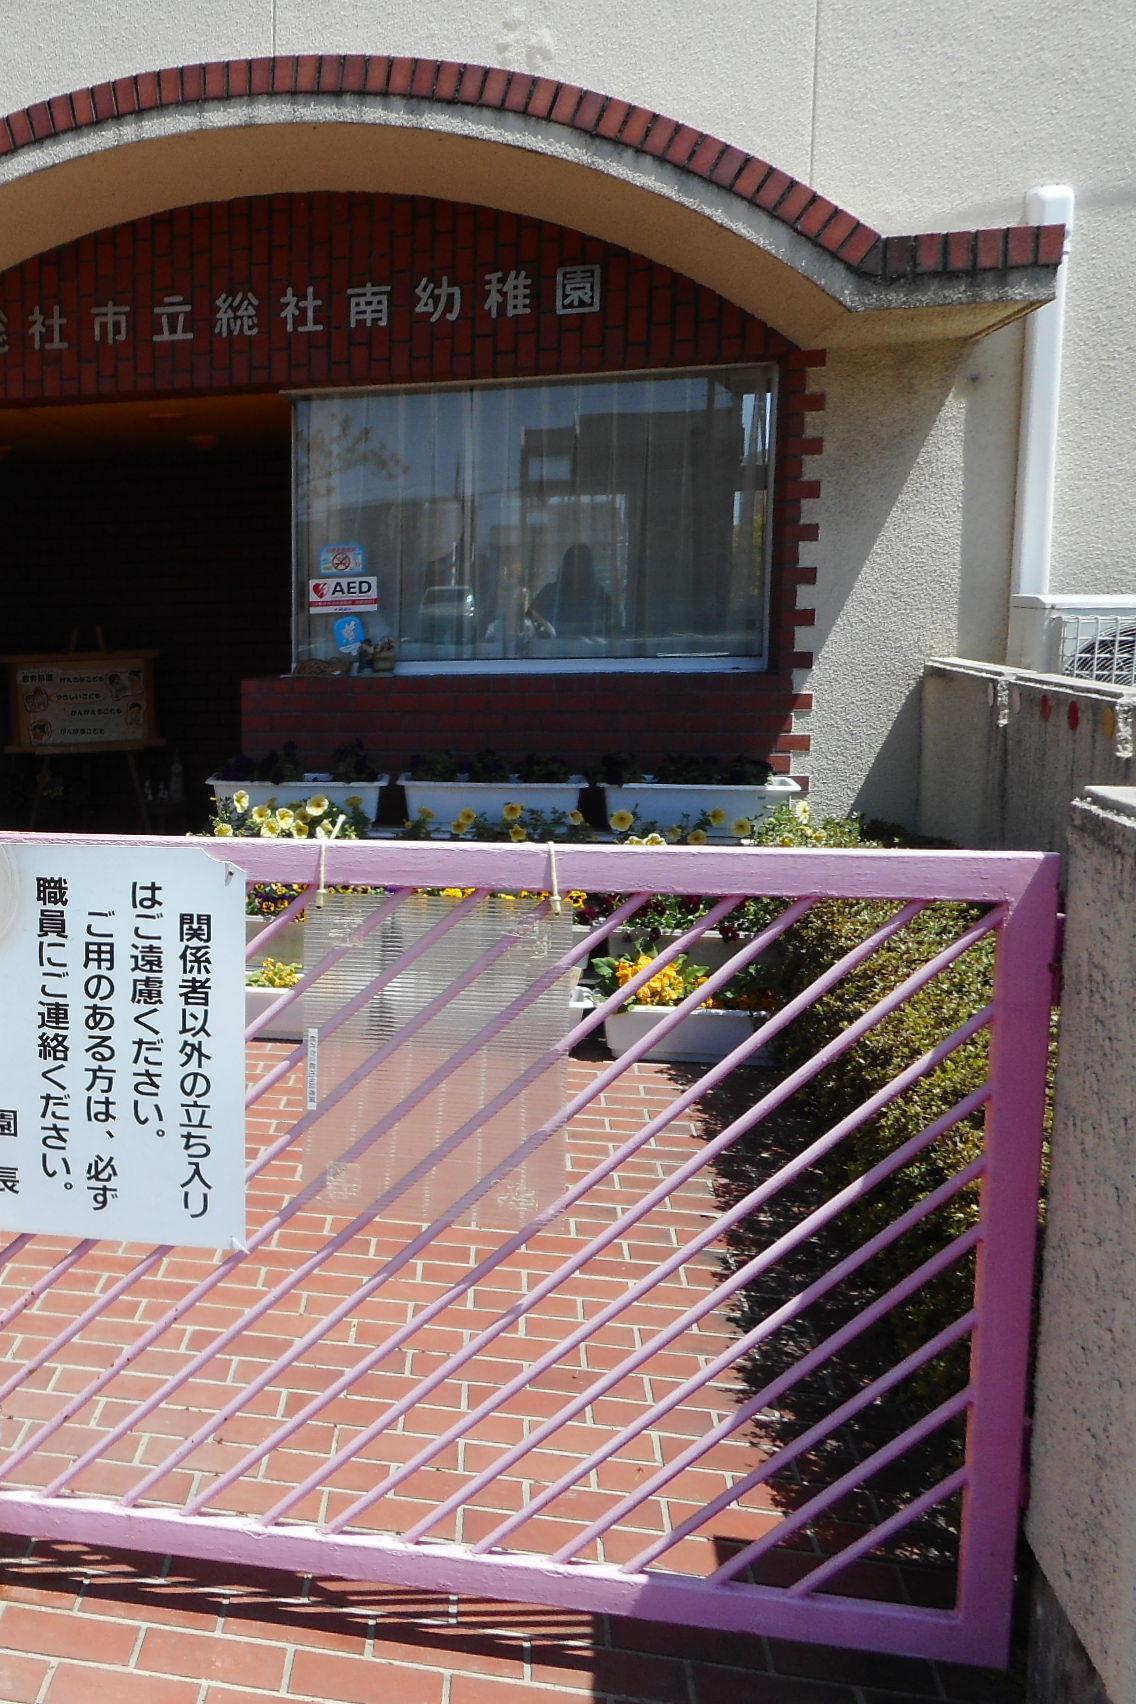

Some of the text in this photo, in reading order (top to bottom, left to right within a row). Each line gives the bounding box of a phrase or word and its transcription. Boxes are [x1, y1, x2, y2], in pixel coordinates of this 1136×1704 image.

[331, 580, 372, 595] AED
[35, 876, 73, 1192] 職員にご連絡ください。
[83, 910, 119, 1211] ご用のある方は、必ず
[130, 880, 166, 1138] はご遠慮ください。
[178, 913, 213, 1218] 関係者以外の立ち入り
